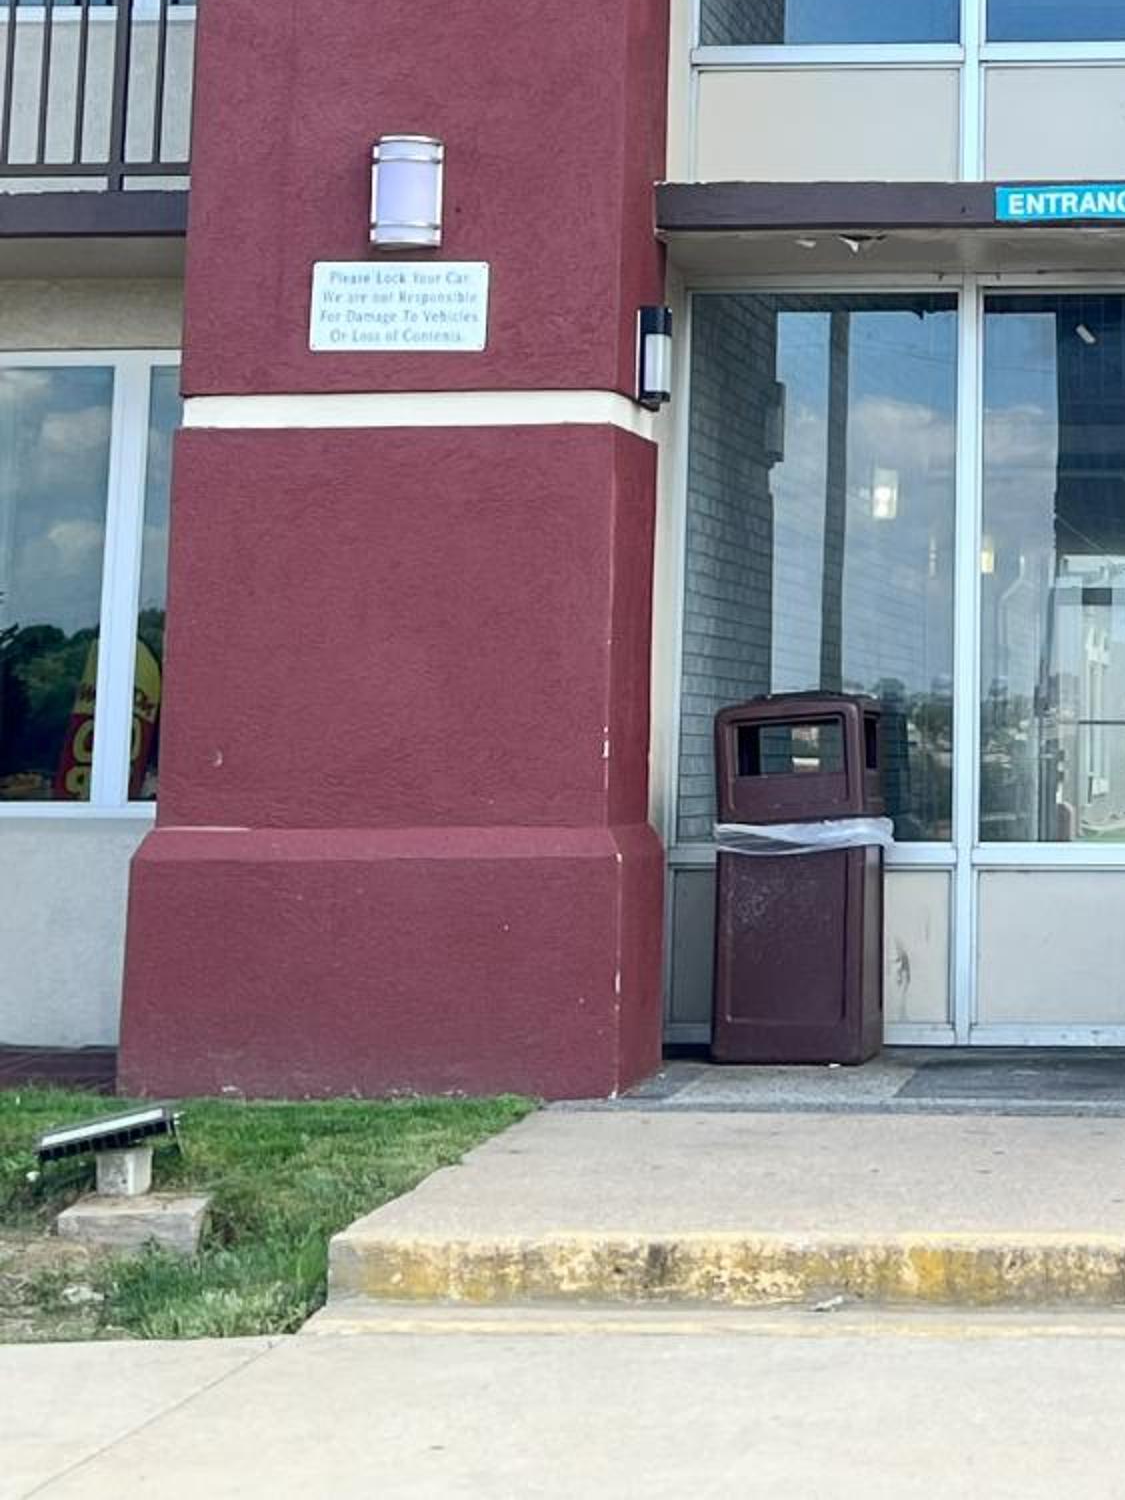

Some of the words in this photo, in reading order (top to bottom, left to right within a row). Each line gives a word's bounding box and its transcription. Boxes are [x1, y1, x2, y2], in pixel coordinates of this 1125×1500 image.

[330, 271, 371, 284] Please
[376, 271, 406, 284] Lock
[413, 271, 441, 284] Your
[445, 271, 469, 284] Car
[323, 291, 347, 303] We
[348, 293, 366, 304] are
[372, 291, 394, 303] not
[399, 291, 478, 305] Responsible
[320, 310, 341, 323] For
[346, 310, 397, 325] Damage
[403, 310, 418, 322] To
[423, 309, 479, 322] Vehicles
[329, 329, 347, 343] Or
[352, 329, 381, 343] Loss
[385, 329, 399, 342] of
